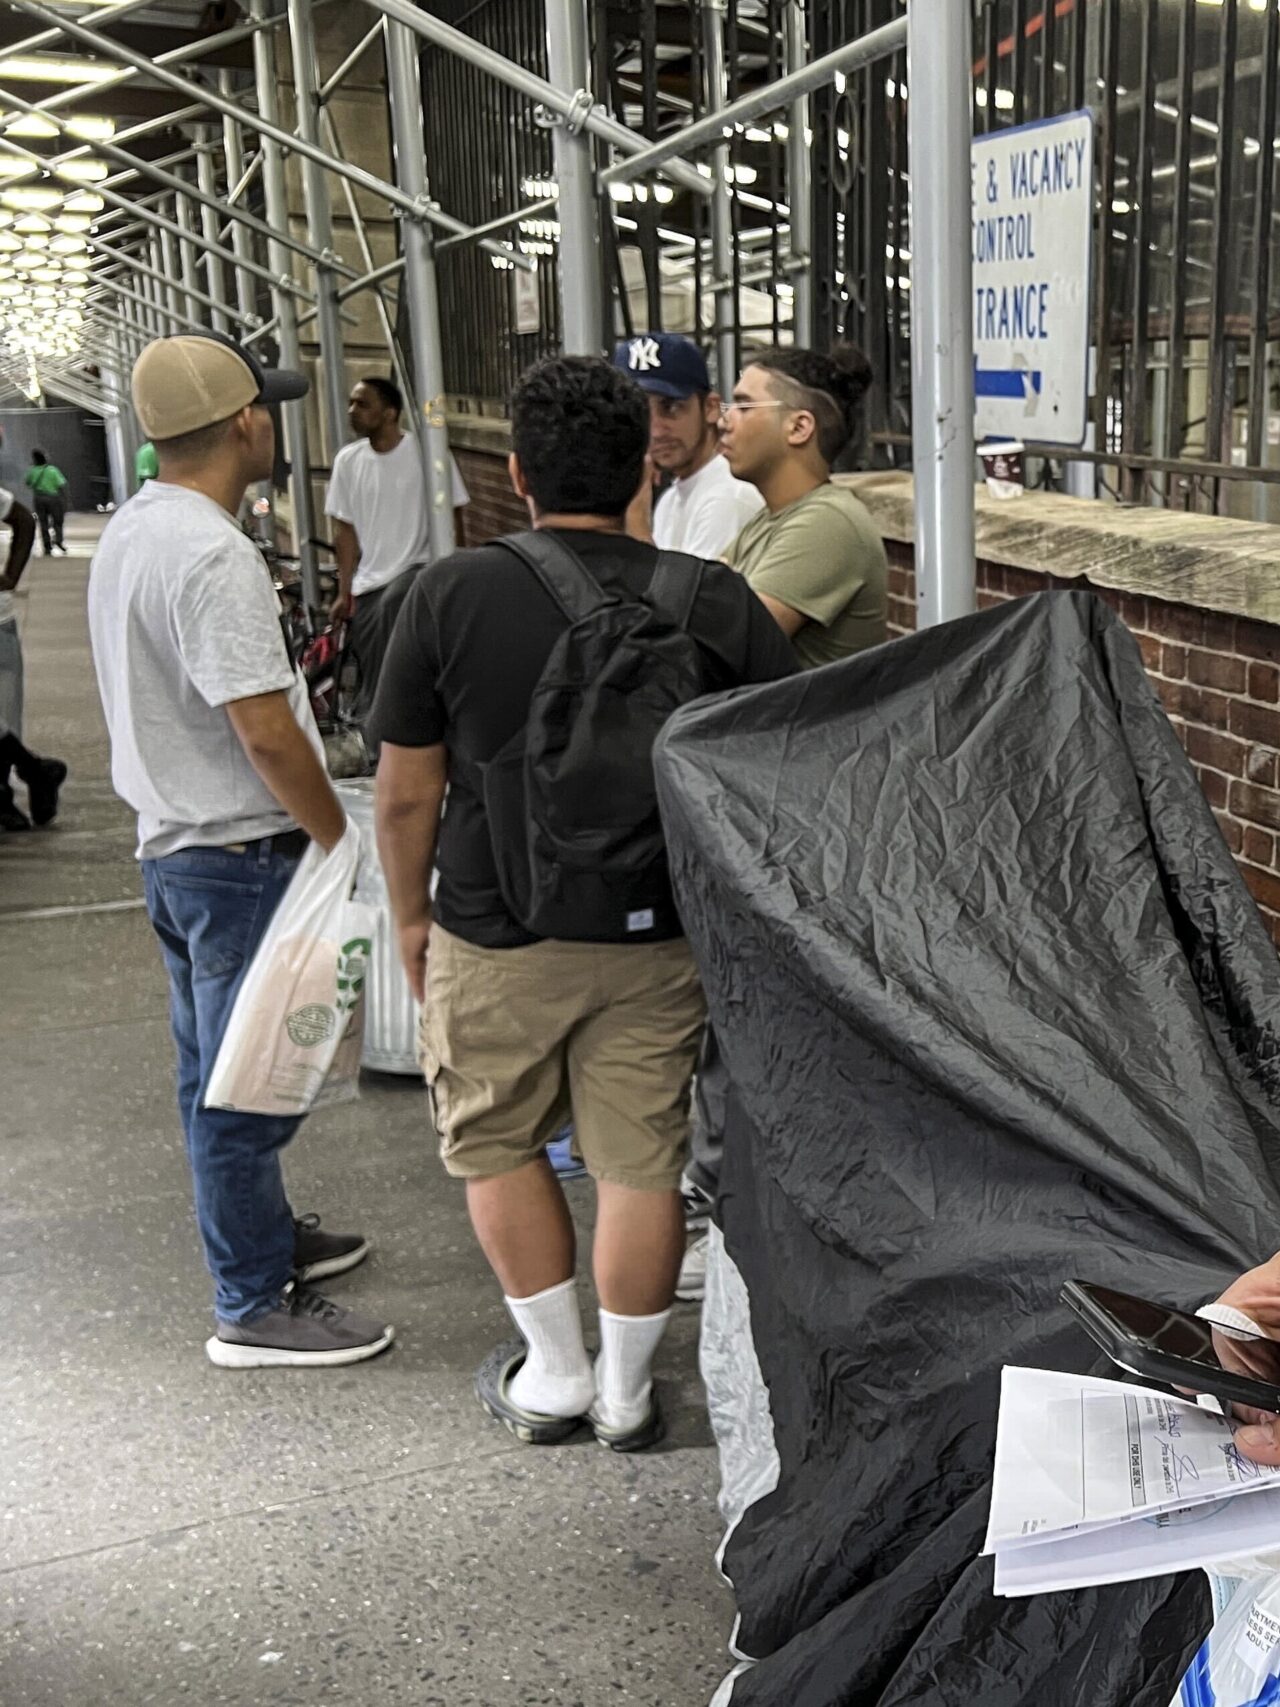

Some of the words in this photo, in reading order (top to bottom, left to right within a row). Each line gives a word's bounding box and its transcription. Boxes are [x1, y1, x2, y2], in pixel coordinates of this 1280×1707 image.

[986, 158, 998, 204] &
[1010, 137, 1085, 200] VACANCY
[971, 212, 1035, 264] ONTROL
[976, 283, 1049, 340] TRANCE
[628, 336, 662, 371] NY
[1131, 1443, 1139, 1455] FOR
[1132, 1467, 1141, 1476] USE
[1246, 1630, 1271, 1653] ADULT
